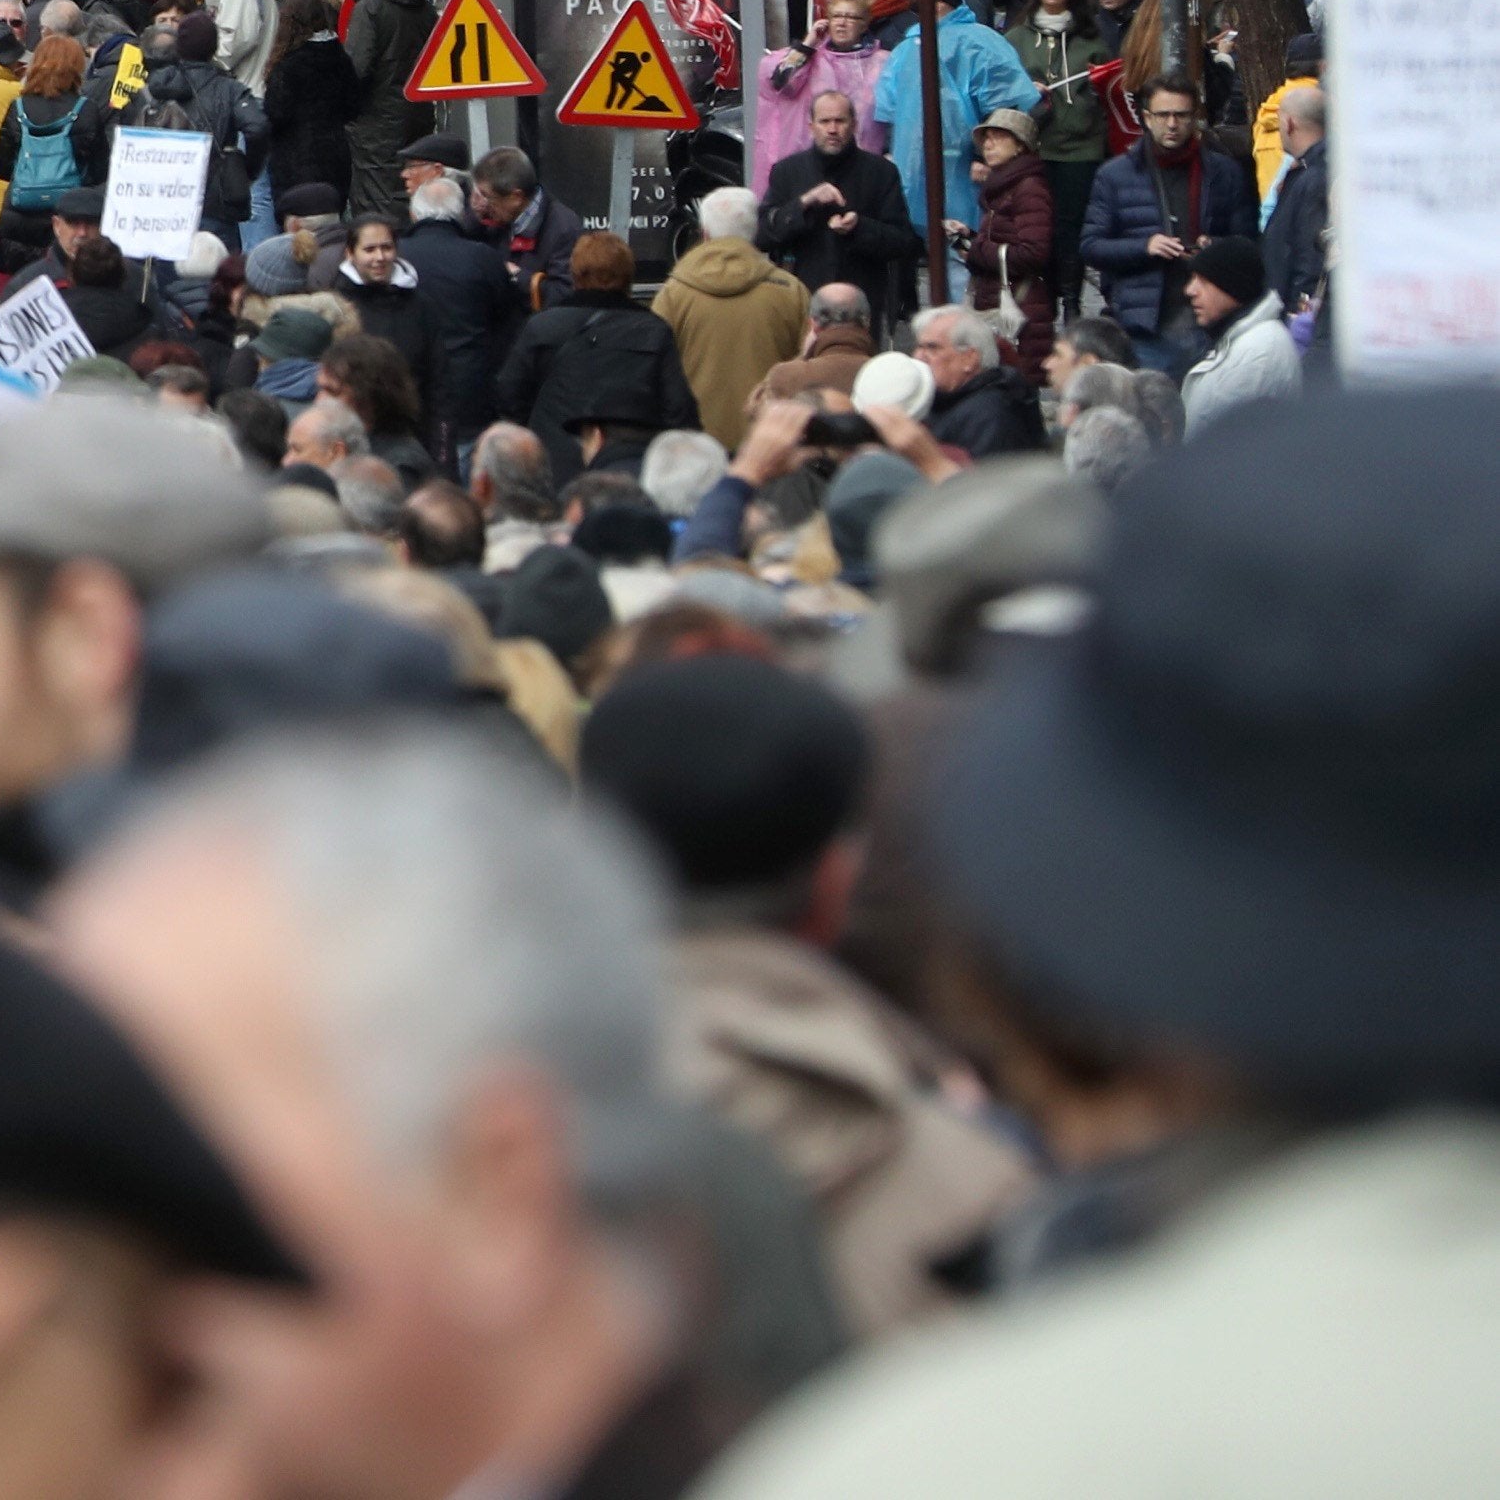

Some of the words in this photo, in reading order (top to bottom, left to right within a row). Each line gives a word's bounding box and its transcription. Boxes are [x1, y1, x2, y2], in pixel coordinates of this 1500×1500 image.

[115, 184, 134, 198] en
[137, 184, 152, 198] su
[158, 178, 198, 199] valor
[112, 209, 128, 230] la
